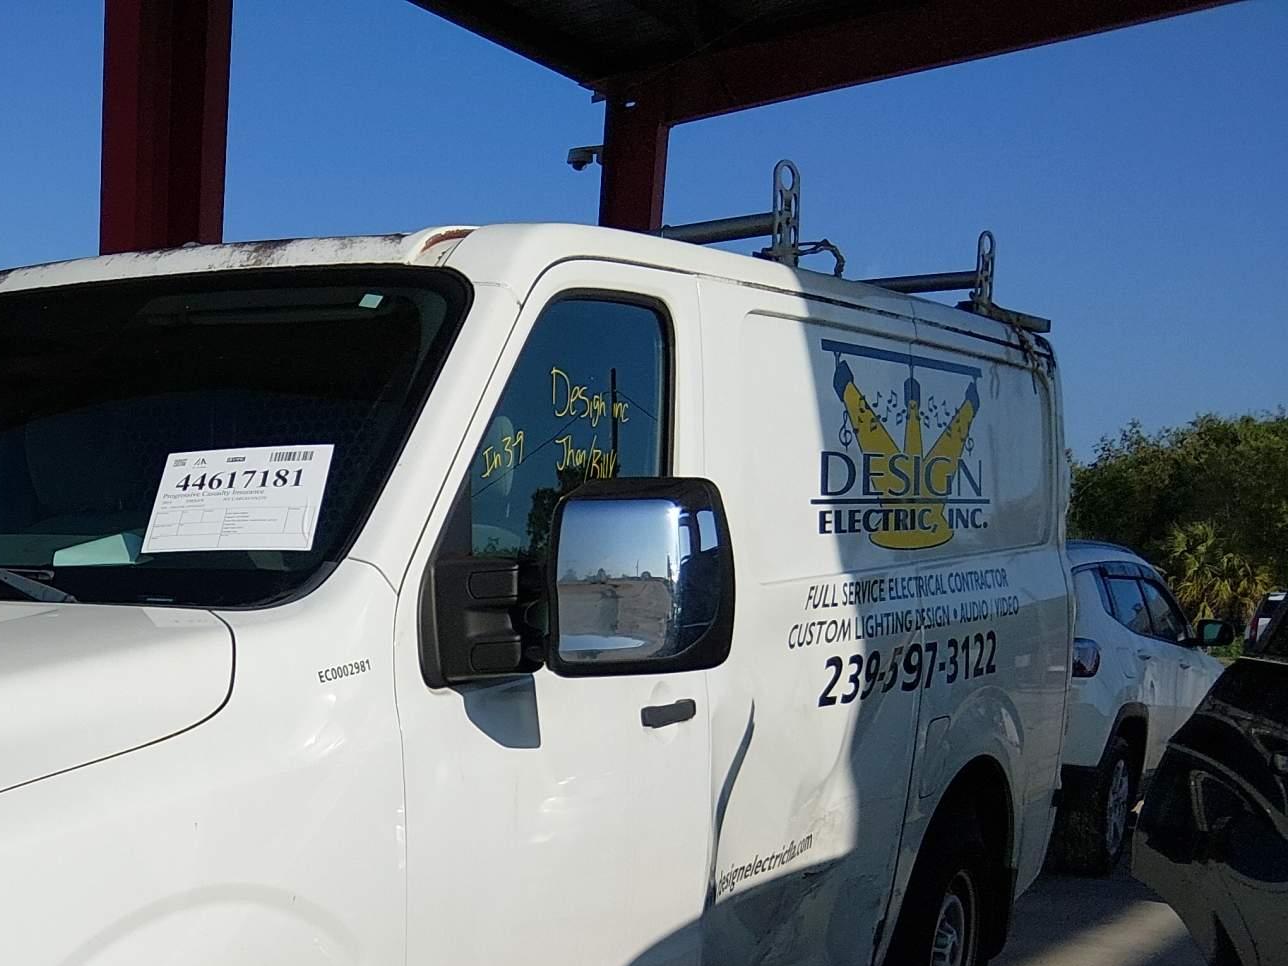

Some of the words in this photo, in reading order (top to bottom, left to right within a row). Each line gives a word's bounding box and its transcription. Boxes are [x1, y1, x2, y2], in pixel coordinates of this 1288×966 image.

[176, 467, 305, 491] 44617181
[820, 451, 982, 497] DESIGN
[819, 508, 938, 534] ELECTRIC,
[948, 508, 988, 529] INC.
[805, 584, 839, 610] FULL
[842, 578, 886, 605] SERVICE
[888, 575, 947, 601] ELECTRICAL
[948, 568, 1008, 594] CONTRACTOR
[788, 619, 851, 649] CUSTOM
[855, 610, 913, 640] LIGHTING
[915, 605, 951, 631] DESIGN
[959, 600, 988, 624] AUDIO
[995, 595, 1020, 617] VIDEO
[318, 658, 371, 683] EC0002981
[817, 630, 997, 708] 239-597-3122
